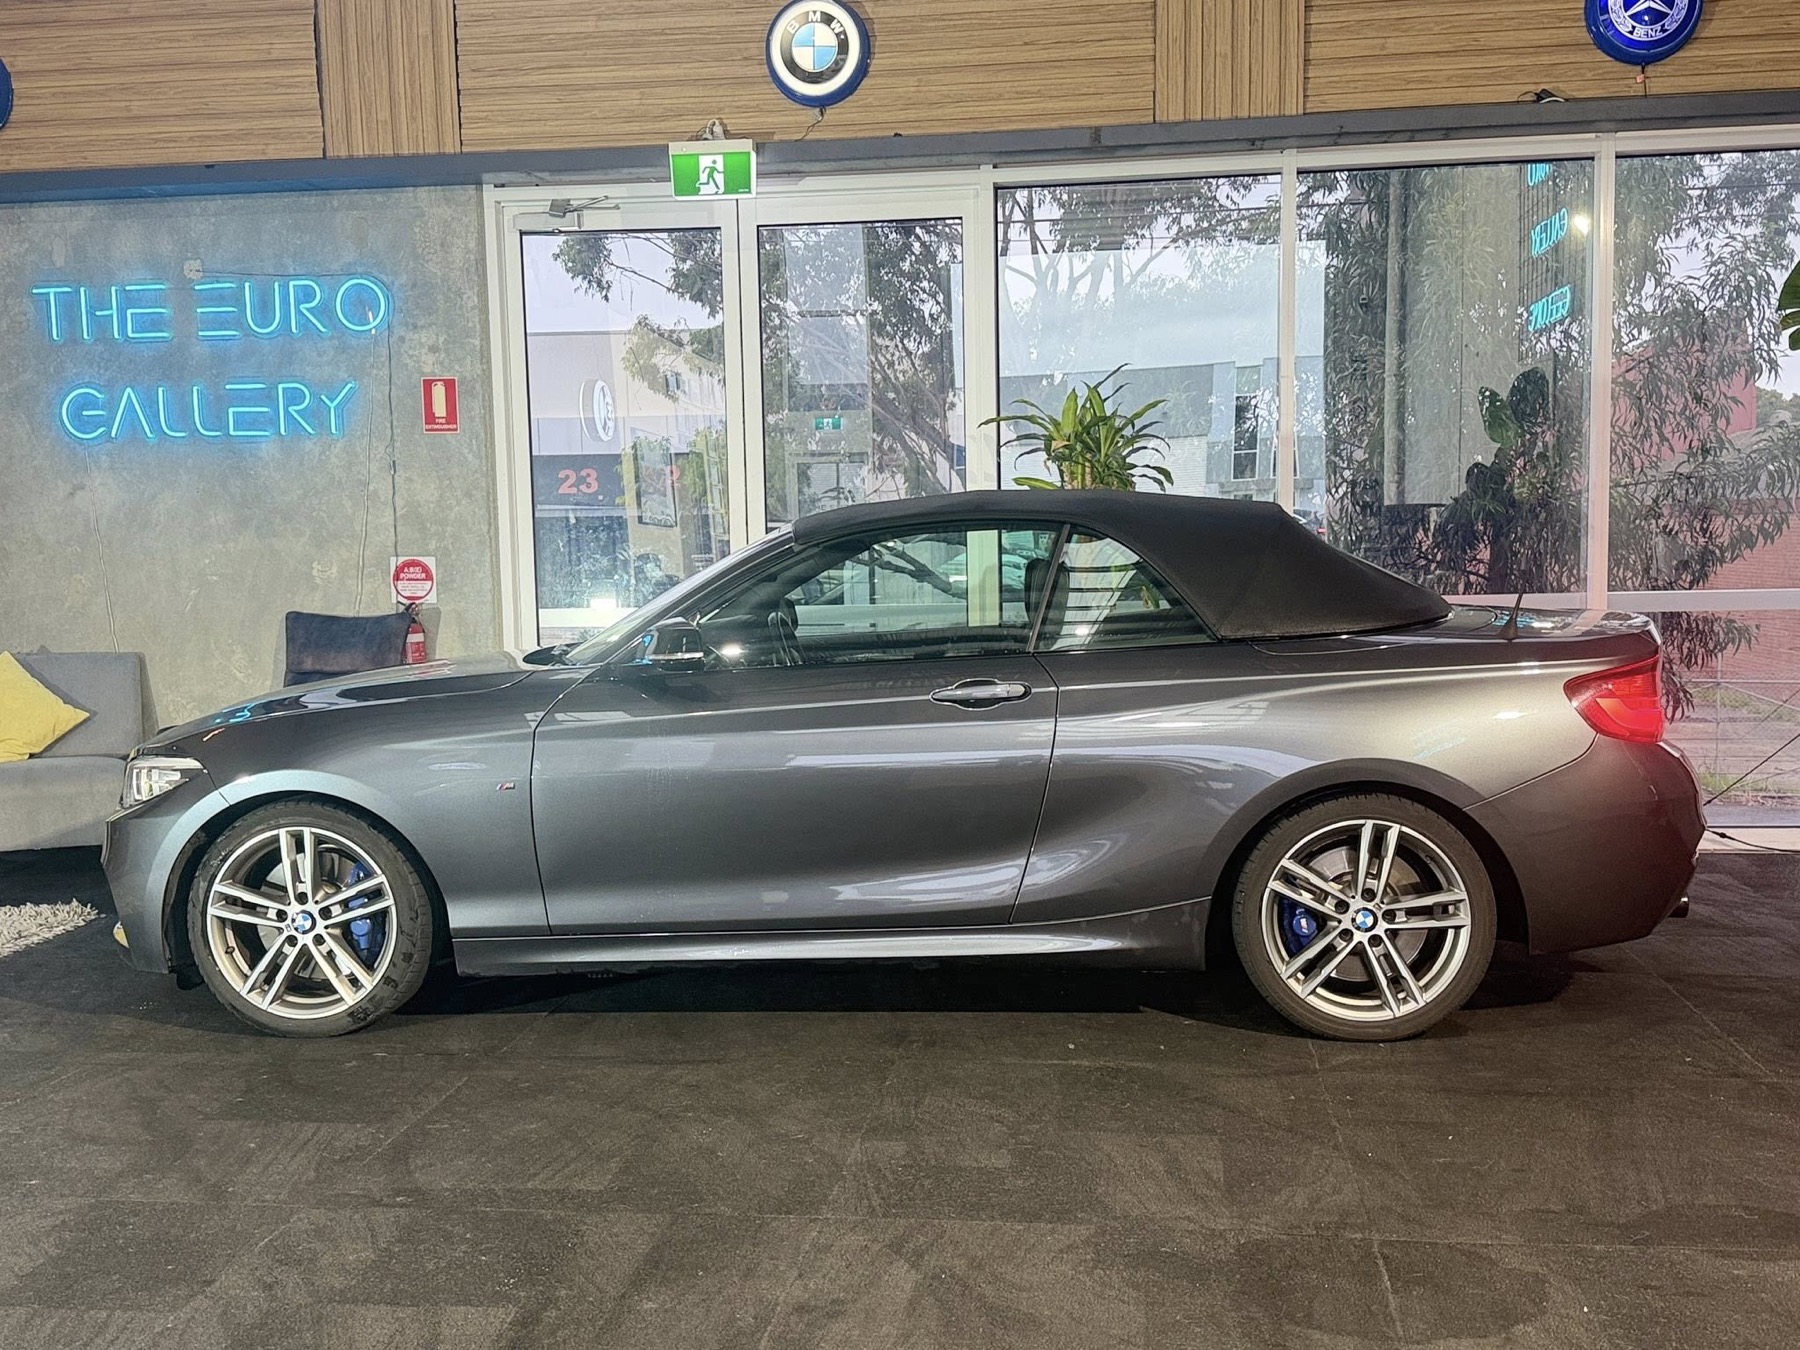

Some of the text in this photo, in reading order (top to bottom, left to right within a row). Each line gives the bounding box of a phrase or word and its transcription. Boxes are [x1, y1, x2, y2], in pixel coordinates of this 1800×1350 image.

[787, 10, 844, 34] BMW
[1633, 26, 1663, 38] BENZ
[32, 278, 387, 340] THE EURO
[61, 381, 356, 439] GALLERY
[558, 468, 599, 494] 23
